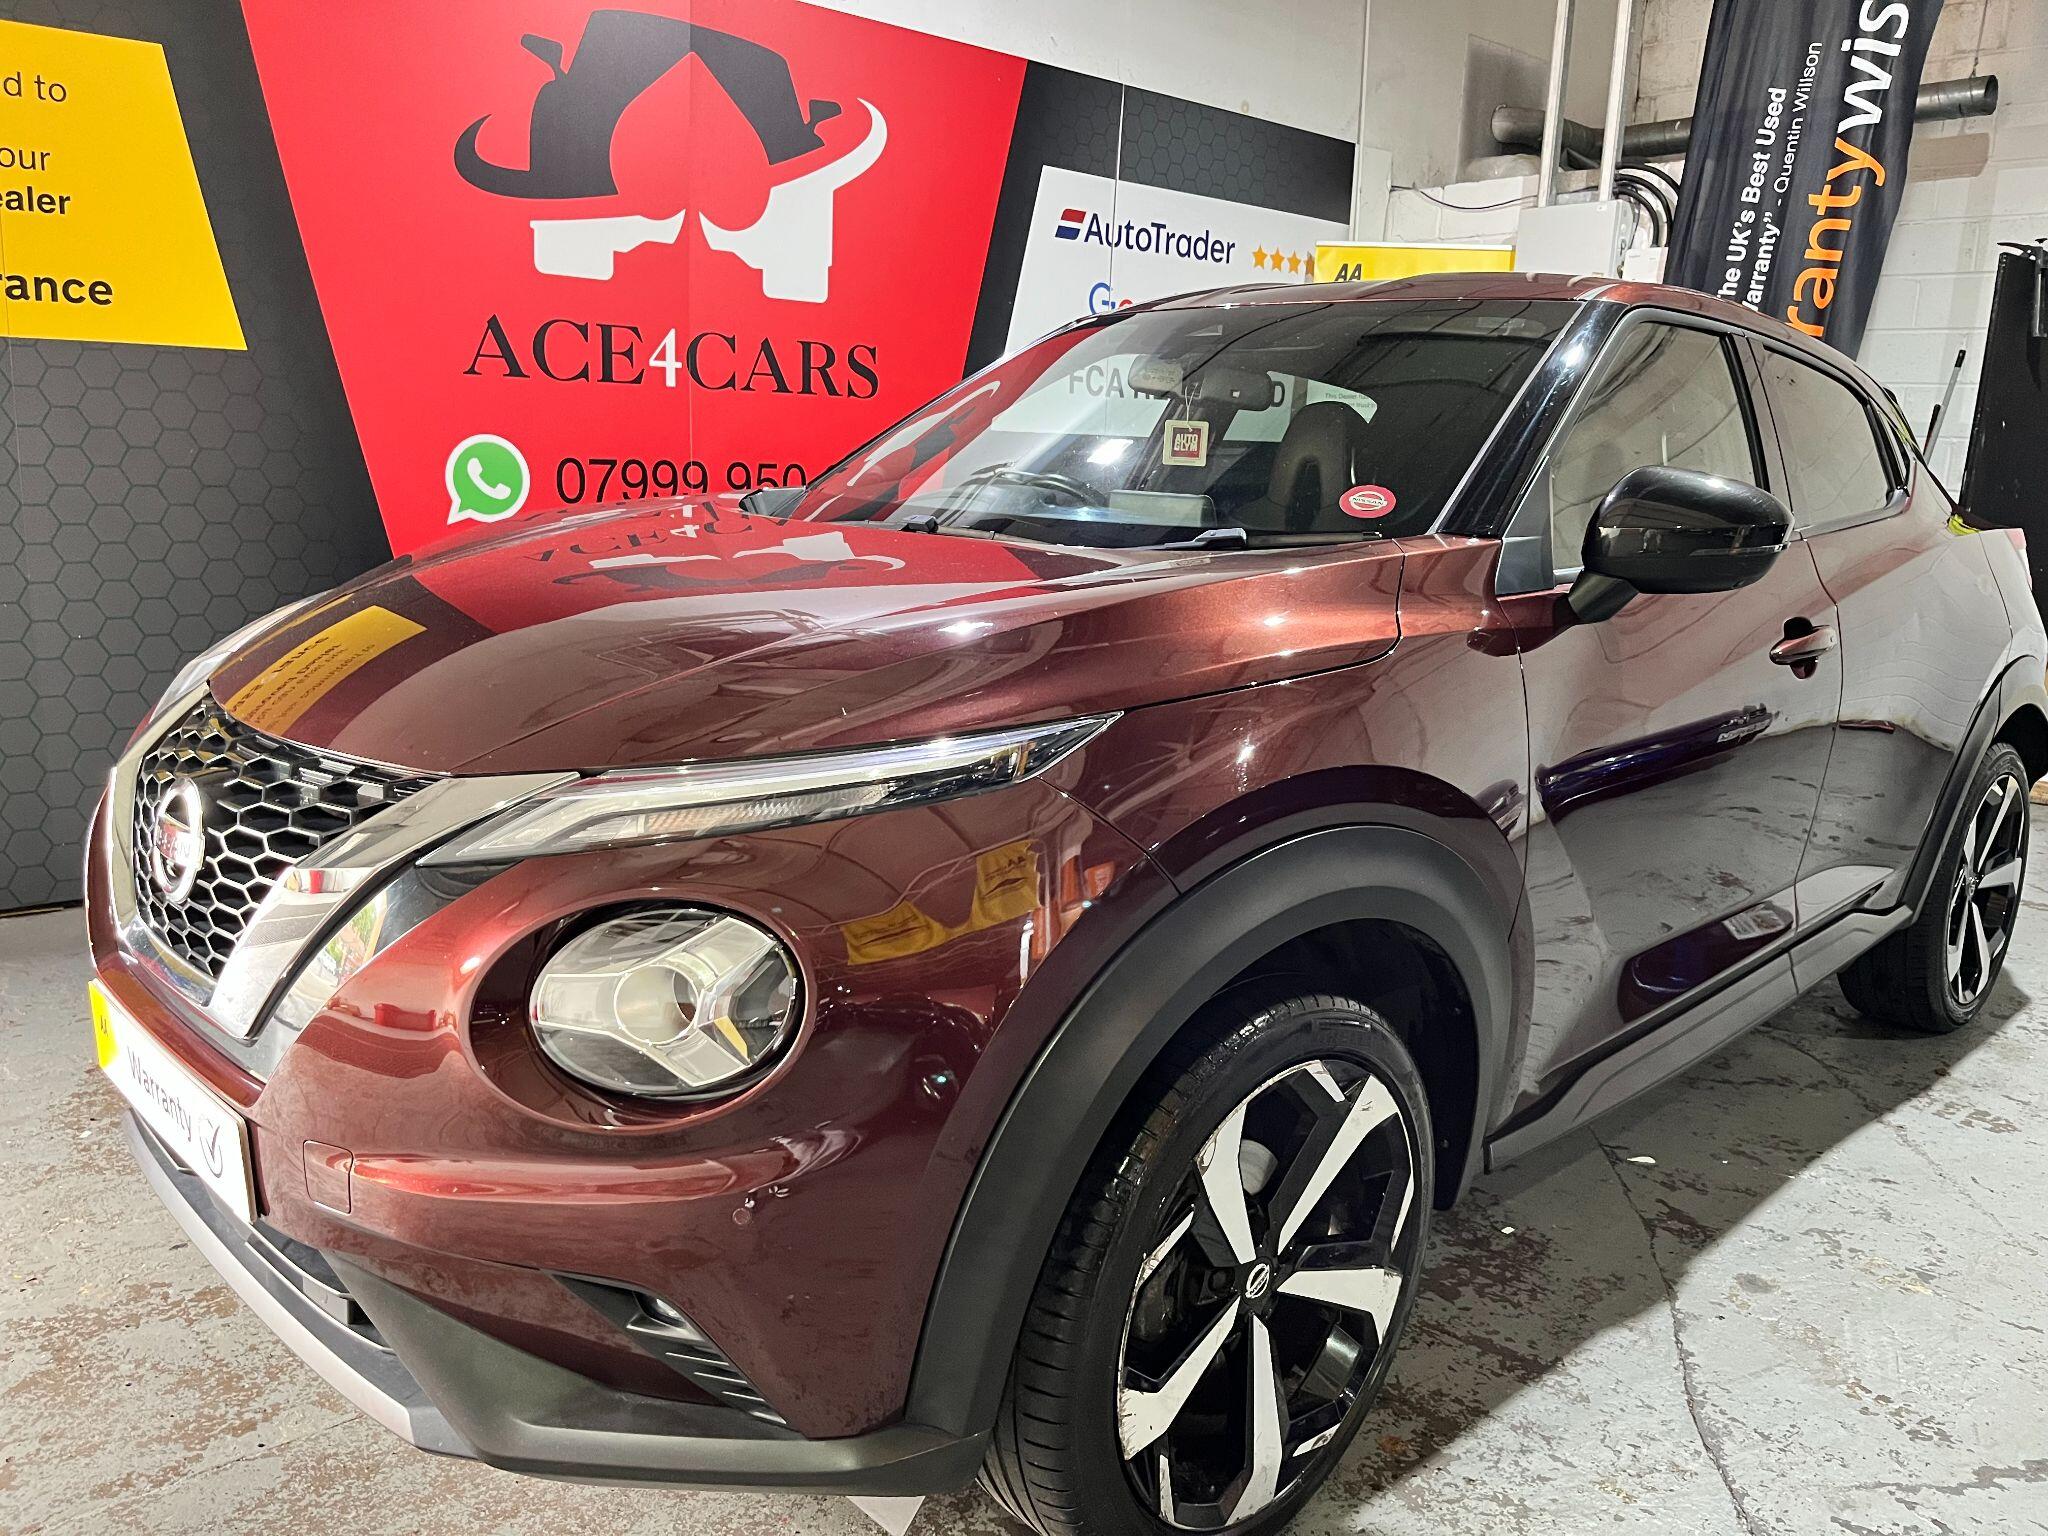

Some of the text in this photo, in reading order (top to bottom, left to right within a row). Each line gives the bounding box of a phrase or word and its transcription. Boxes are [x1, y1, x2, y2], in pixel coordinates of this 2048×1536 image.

[35, 75, 67, 103] to
[1716, 87, 1787, 298] he UK's Best Used
[1742, 211, 1781, 312] arranty"
[1773, 118, 1804, 193] Quentin
[1792, 41, 1823, 112] Willson
[1084, 213, 1236, 264] AutoTrader
[0, 273, 113, 306] ance
[1334, 263, 1362, 282] AA
[463, 314, 879, 399] ACE4CARS
[1069, 365, 1124, 398] FCA
[556, 457, 709, 504] 07999
[126, 1045, 192, 1143] Warranty
